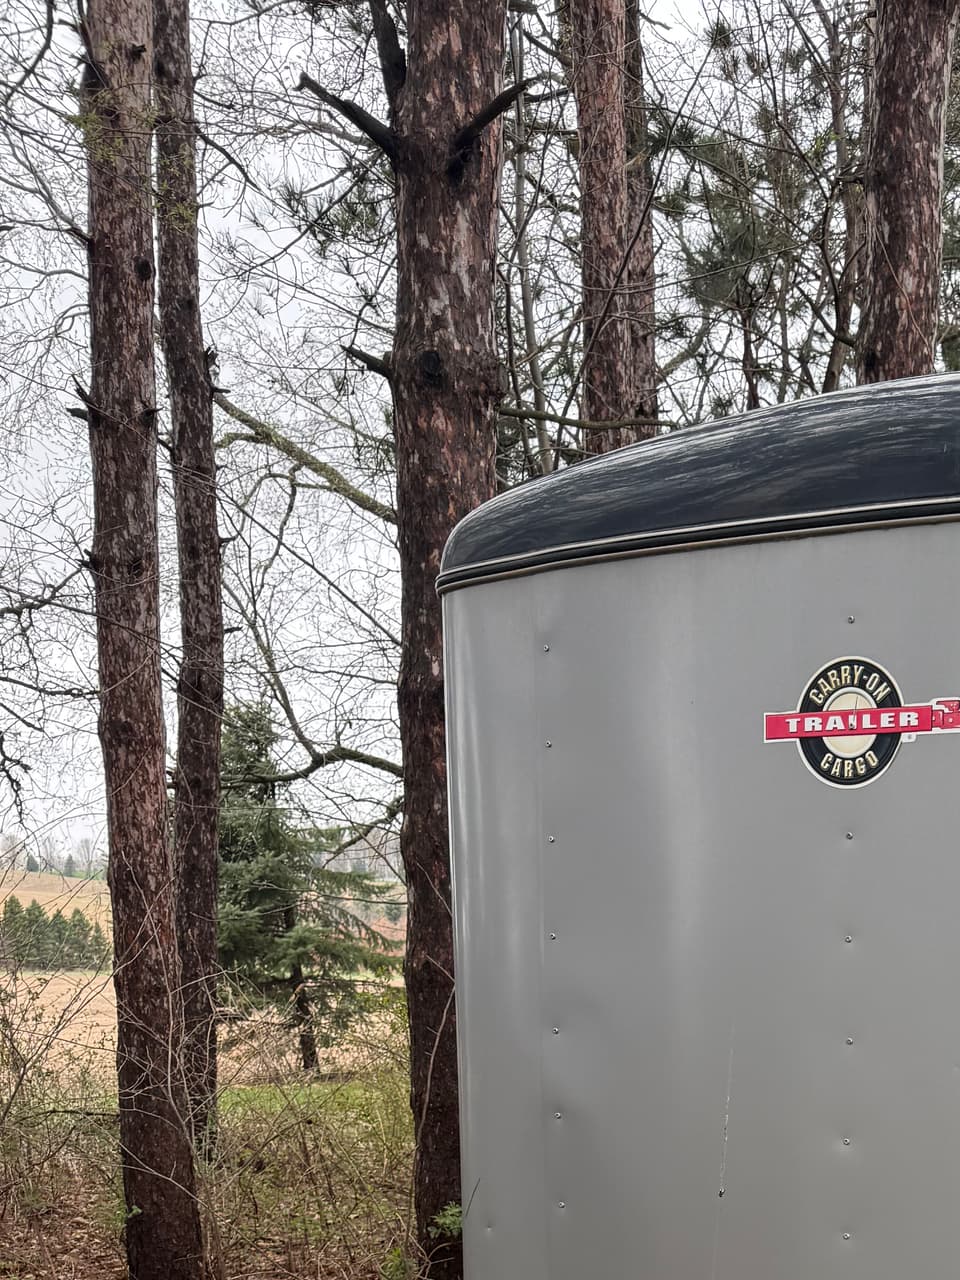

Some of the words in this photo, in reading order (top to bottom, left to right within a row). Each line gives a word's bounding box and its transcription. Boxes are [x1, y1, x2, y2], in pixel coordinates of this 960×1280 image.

[809, 664, 891, 707] CARRY-ON
[786, 711, 919, 732] TRAILER
[820, 750, 880, 778] CARGO
